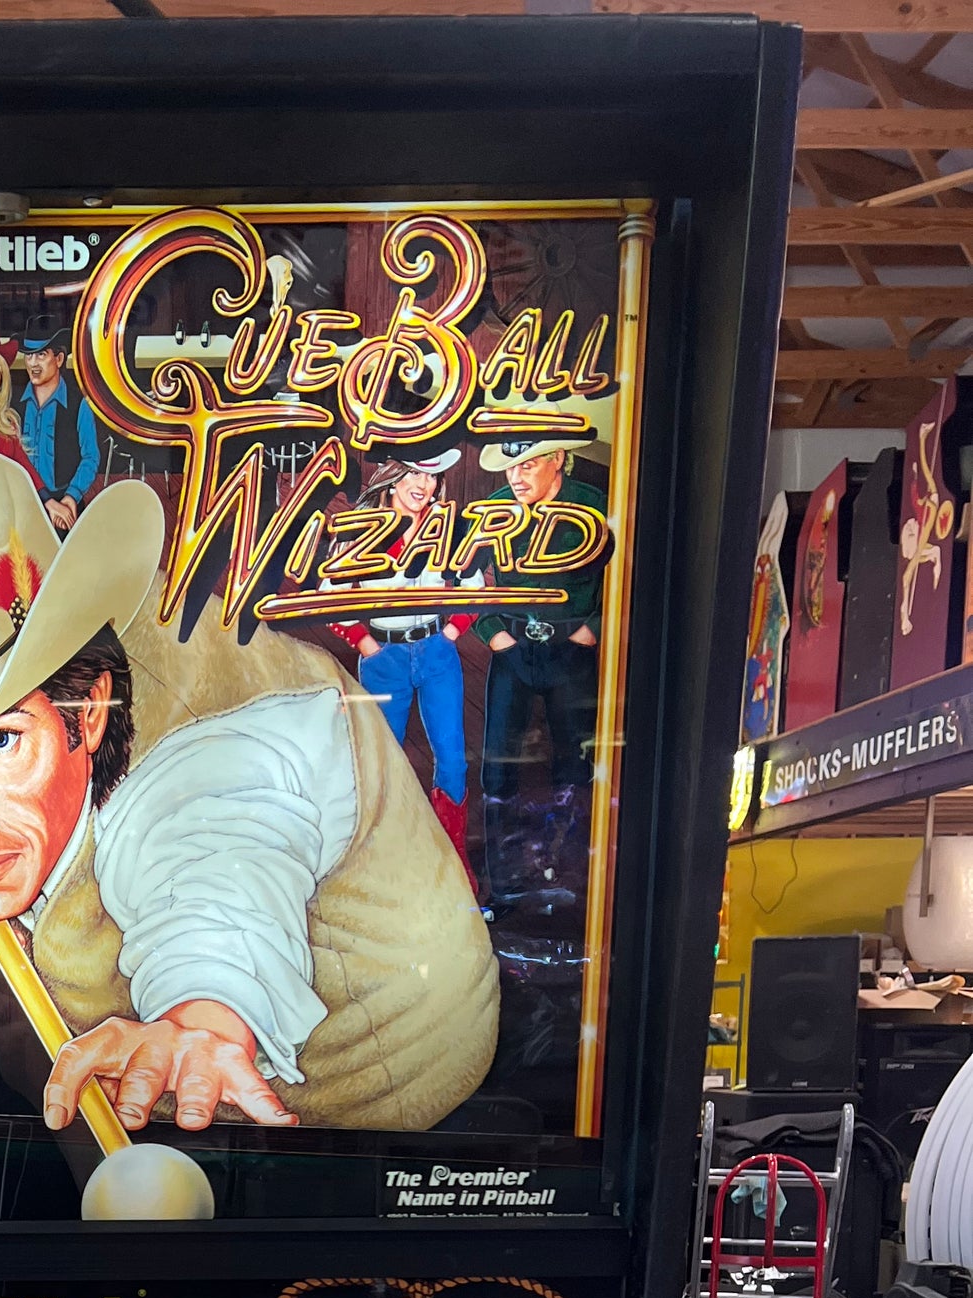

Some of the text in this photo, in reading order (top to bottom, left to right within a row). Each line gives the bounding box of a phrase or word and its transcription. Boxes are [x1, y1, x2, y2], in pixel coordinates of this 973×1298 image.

[385, 1165, 530, 1187] The Premier
[397, 1189, 556, 1206] Name in Pinball
